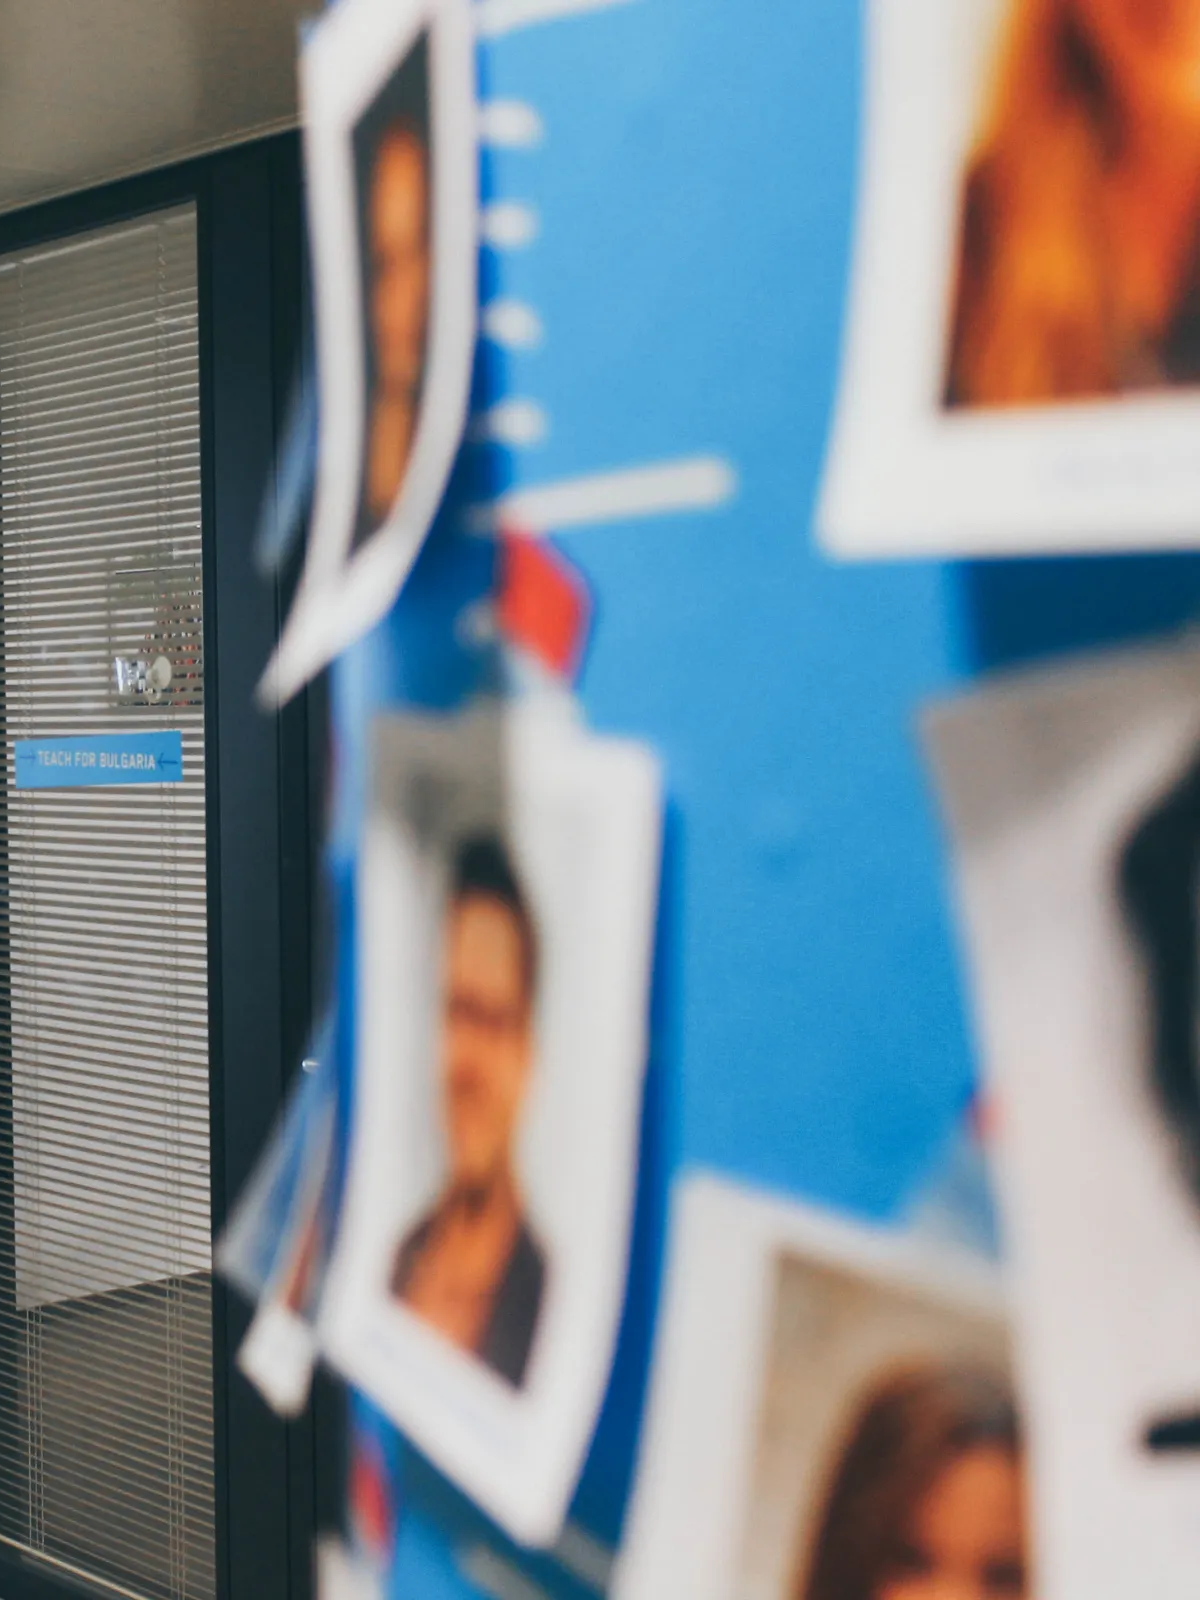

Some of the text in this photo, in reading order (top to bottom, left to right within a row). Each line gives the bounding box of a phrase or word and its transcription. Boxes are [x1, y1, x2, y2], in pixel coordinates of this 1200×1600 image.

[38, 751, 156, 770] TEACH FOR BULGARIA
